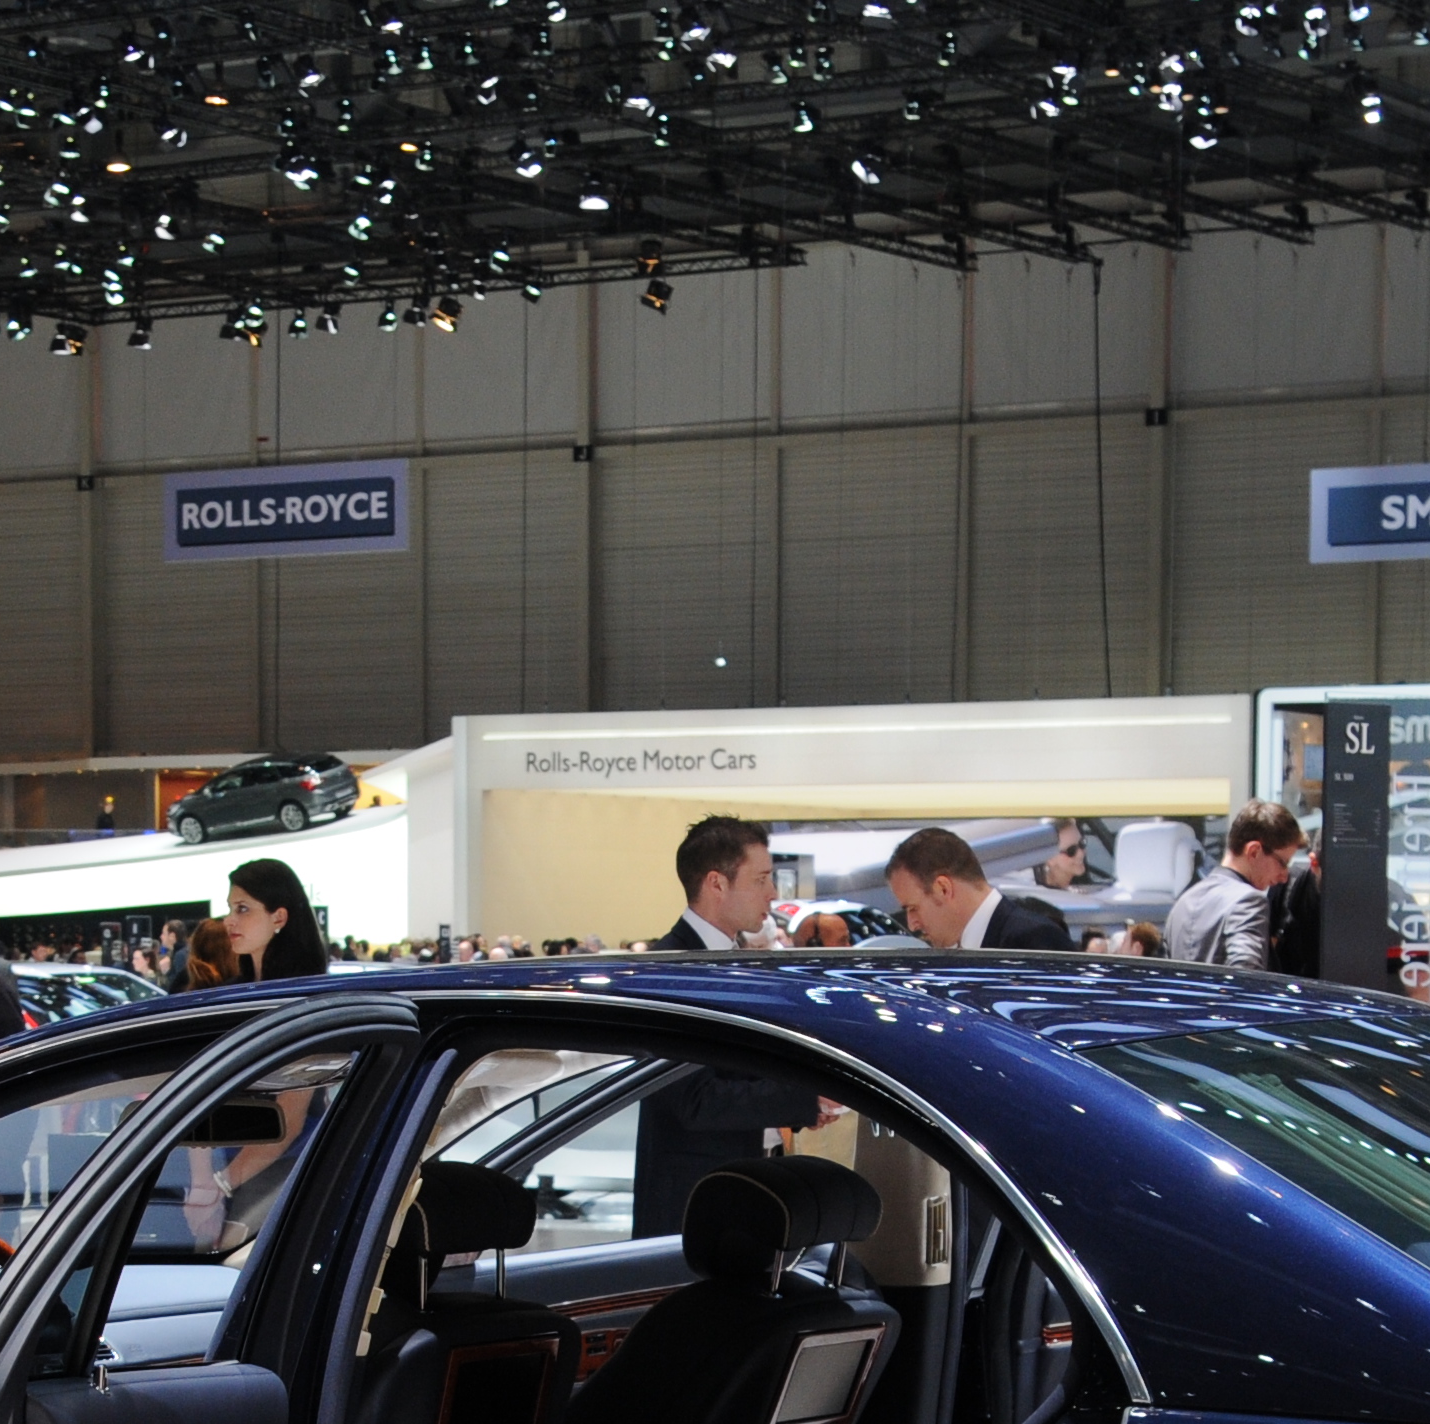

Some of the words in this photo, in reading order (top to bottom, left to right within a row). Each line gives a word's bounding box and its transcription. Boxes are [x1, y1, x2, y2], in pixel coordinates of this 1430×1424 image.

[181, 491, 389, 530] ROLLS-ROYCE
[1345, 721, 1375, 755] SL
[526, 750, 637, 779] Rolls-Royce
[643, 749, 705, 772] Motor
[710, 747, 757, 771] Cars
